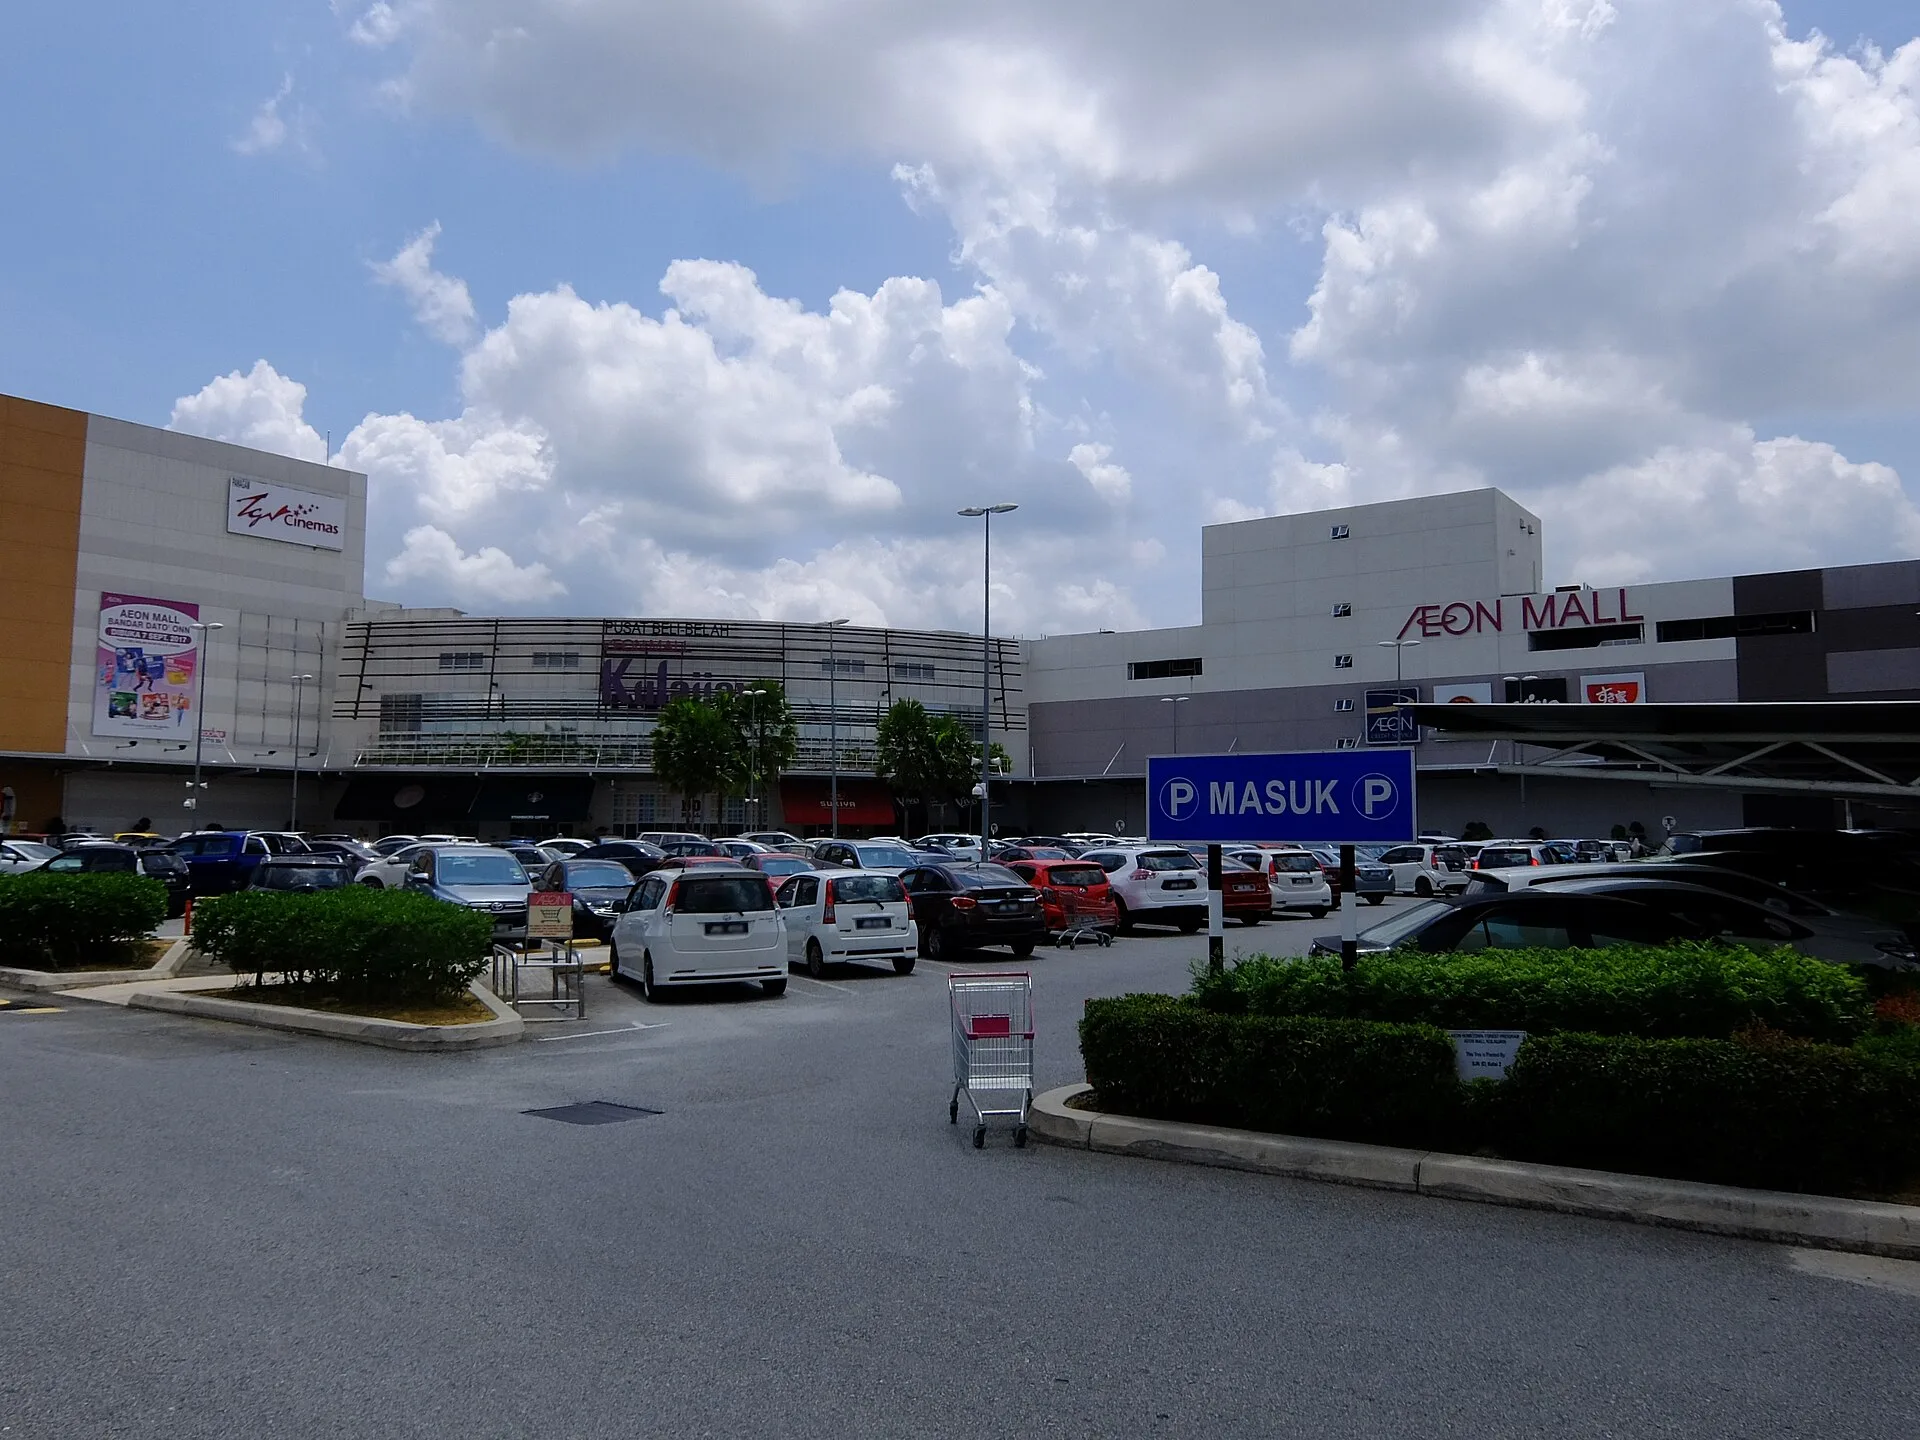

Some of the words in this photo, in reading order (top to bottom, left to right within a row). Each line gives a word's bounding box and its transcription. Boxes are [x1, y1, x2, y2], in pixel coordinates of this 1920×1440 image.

[284, 514, 339, 534] Cinemas
[120, 609, 149, 621] AEON
[152, 613, 179, 624] MALL
[1522, 588, 1645, 630] MALL
[108, 618, 144, 628] BANDAR
[172, 625, 190, 634] ONN
[605, 621, 646, 635] PUSAT
[653, 623, 729, 638] BELI-BELAH
[169, 635, 187, 643] 2017
[1170, 783, 1194, 816] P
[1210, 779, 1340, 815] MASUK
[1364, 779, 1392, 814] P
